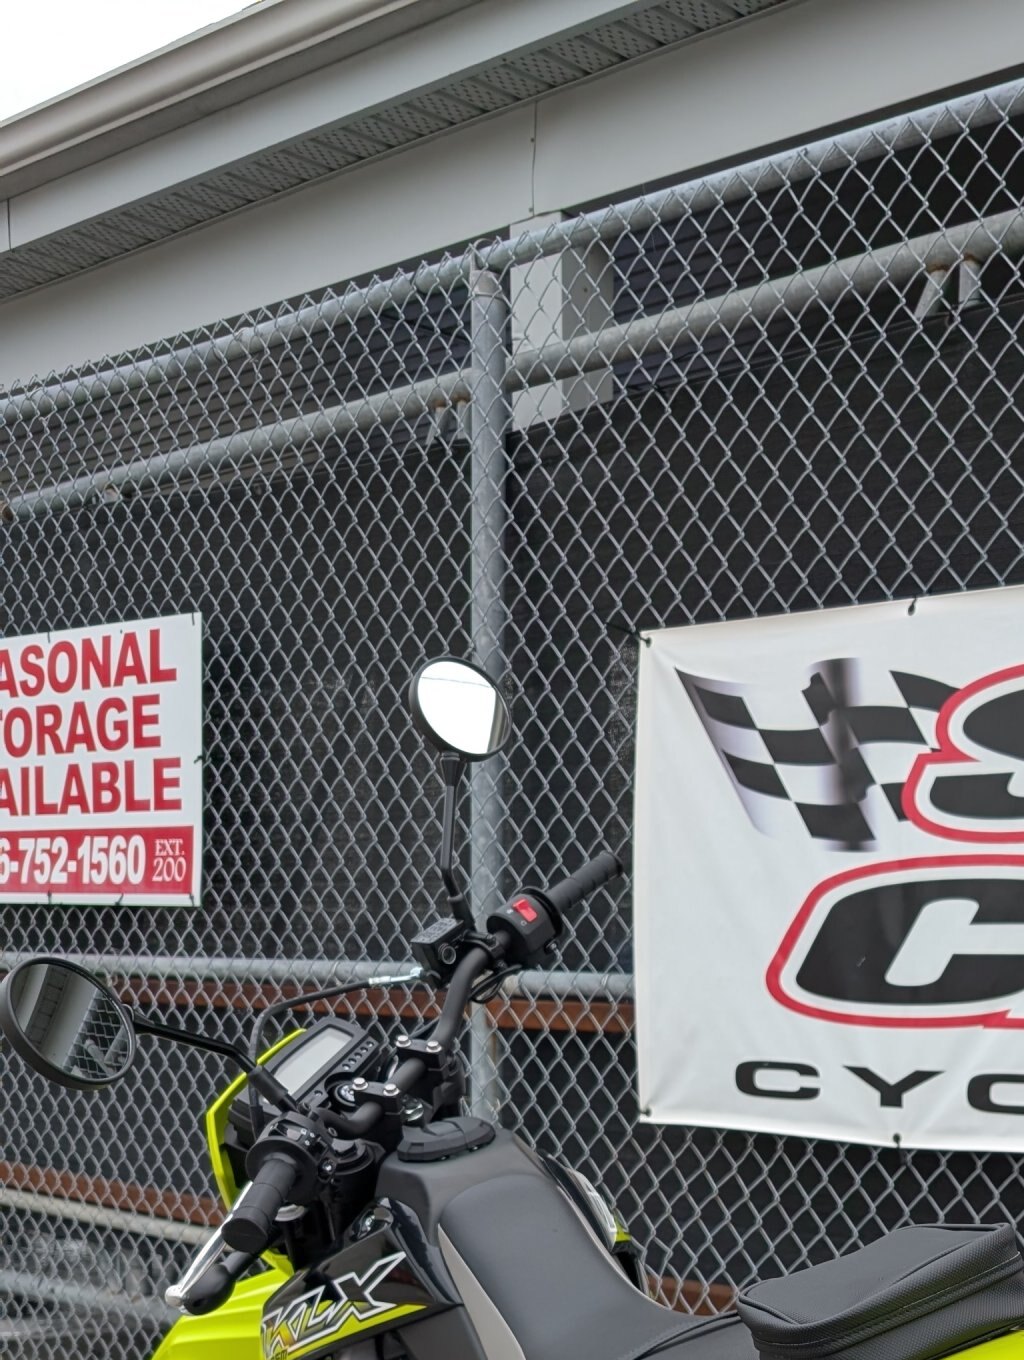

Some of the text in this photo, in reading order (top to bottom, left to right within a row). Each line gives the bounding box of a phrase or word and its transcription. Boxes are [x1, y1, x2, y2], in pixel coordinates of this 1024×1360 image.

[0, 694, 161, 758] ORAGE
[152, 857, 187, 882] 200
[155, 838, 185, 857] EXT.
[262, 1251, 407, 1360] KLX
